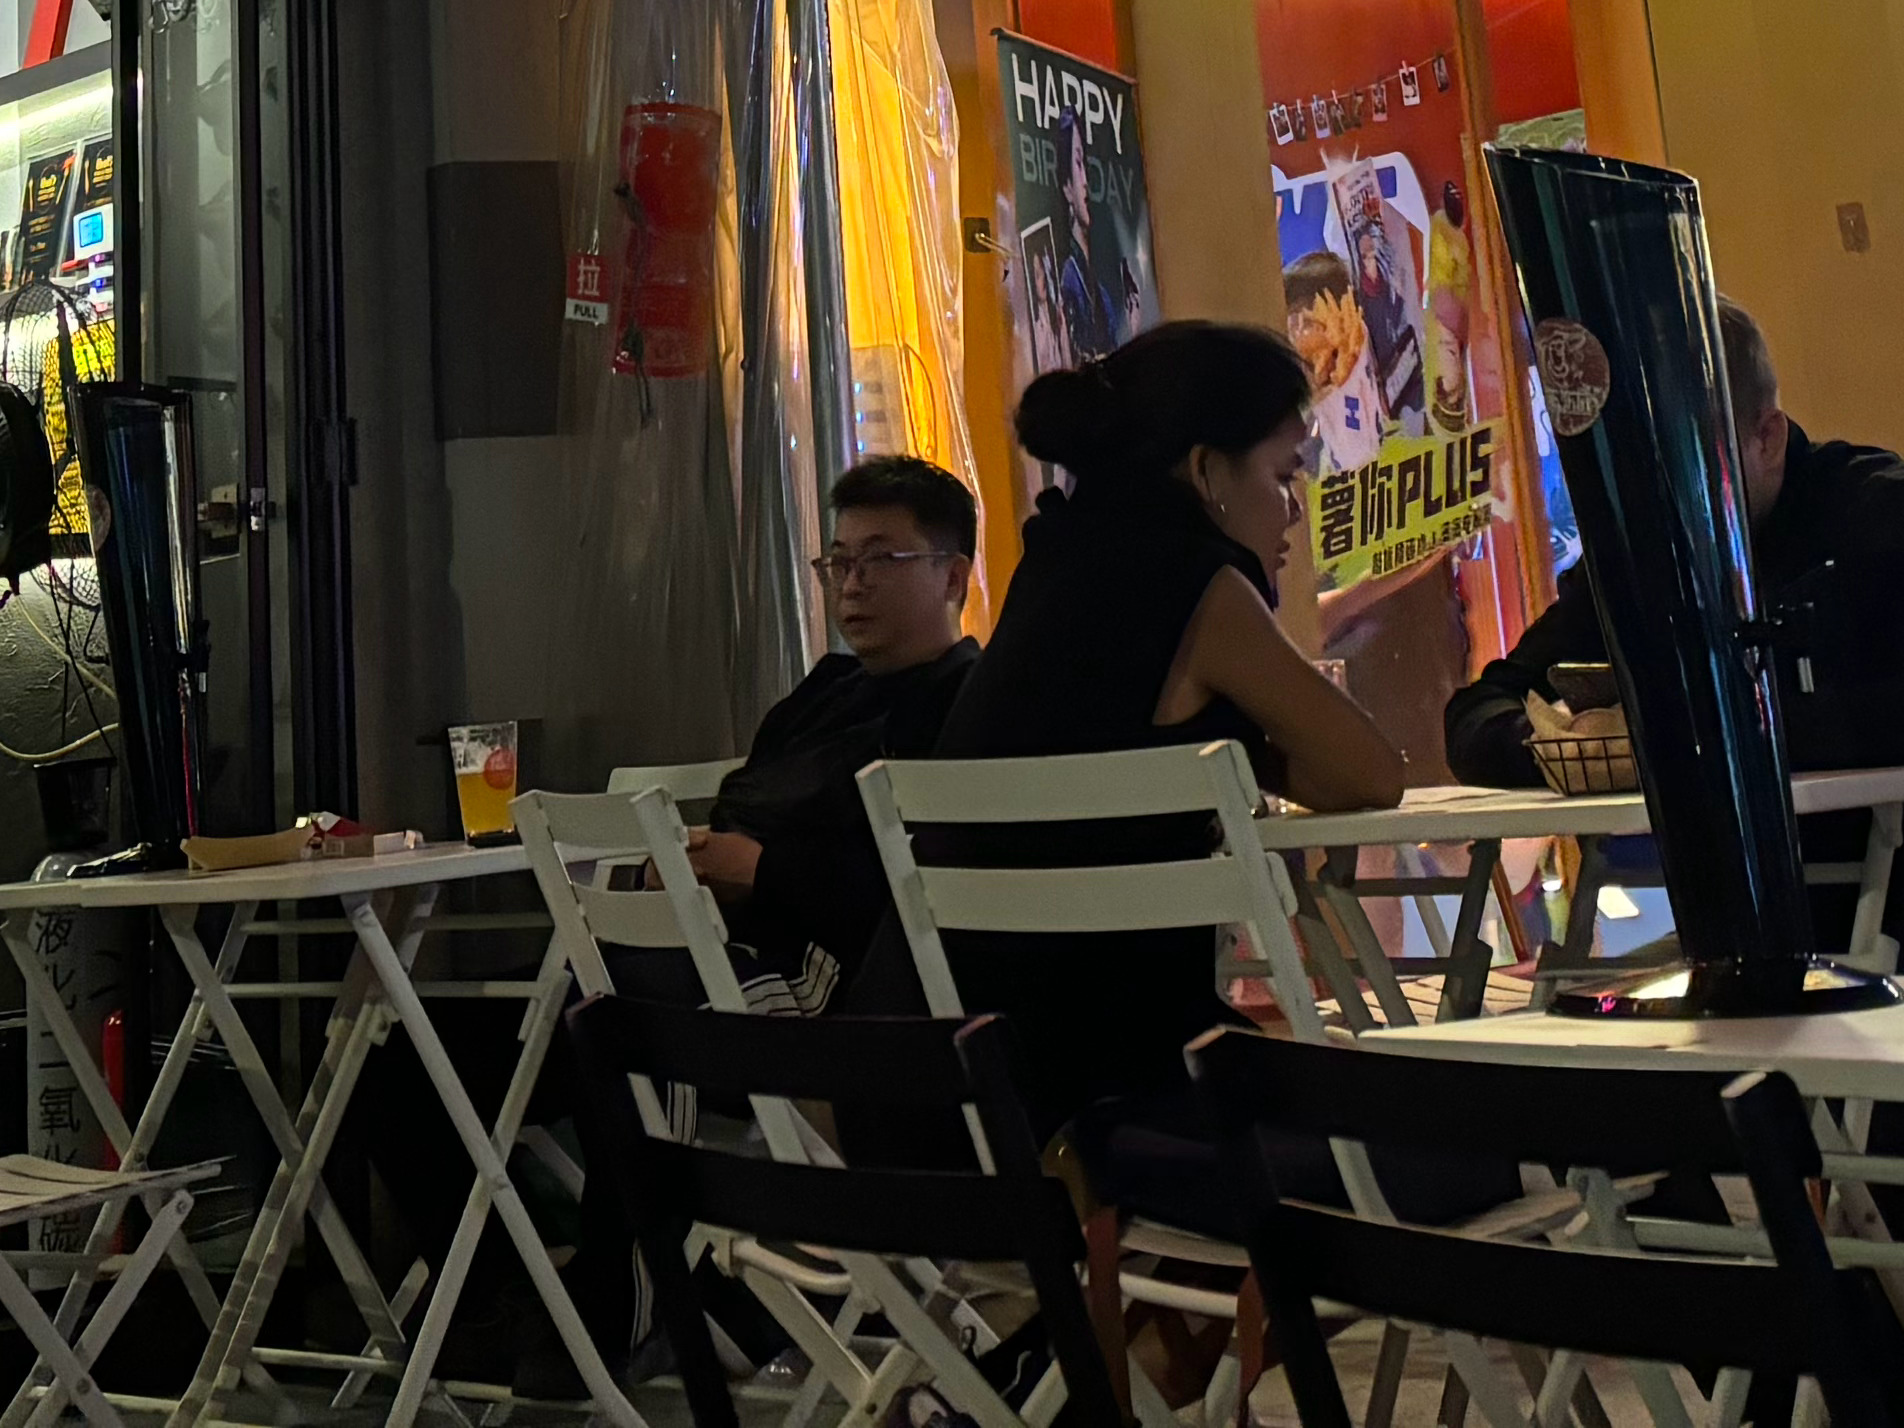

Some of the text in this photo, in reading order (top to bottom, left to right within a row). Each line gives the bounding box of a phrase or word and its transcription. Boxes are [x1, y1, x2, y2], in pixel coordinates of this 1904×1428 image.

[1011, 52, 1123, 155] HAPPY
[577, 257, 601, 296] 拉
[574, 303, 598, 319] PULL
